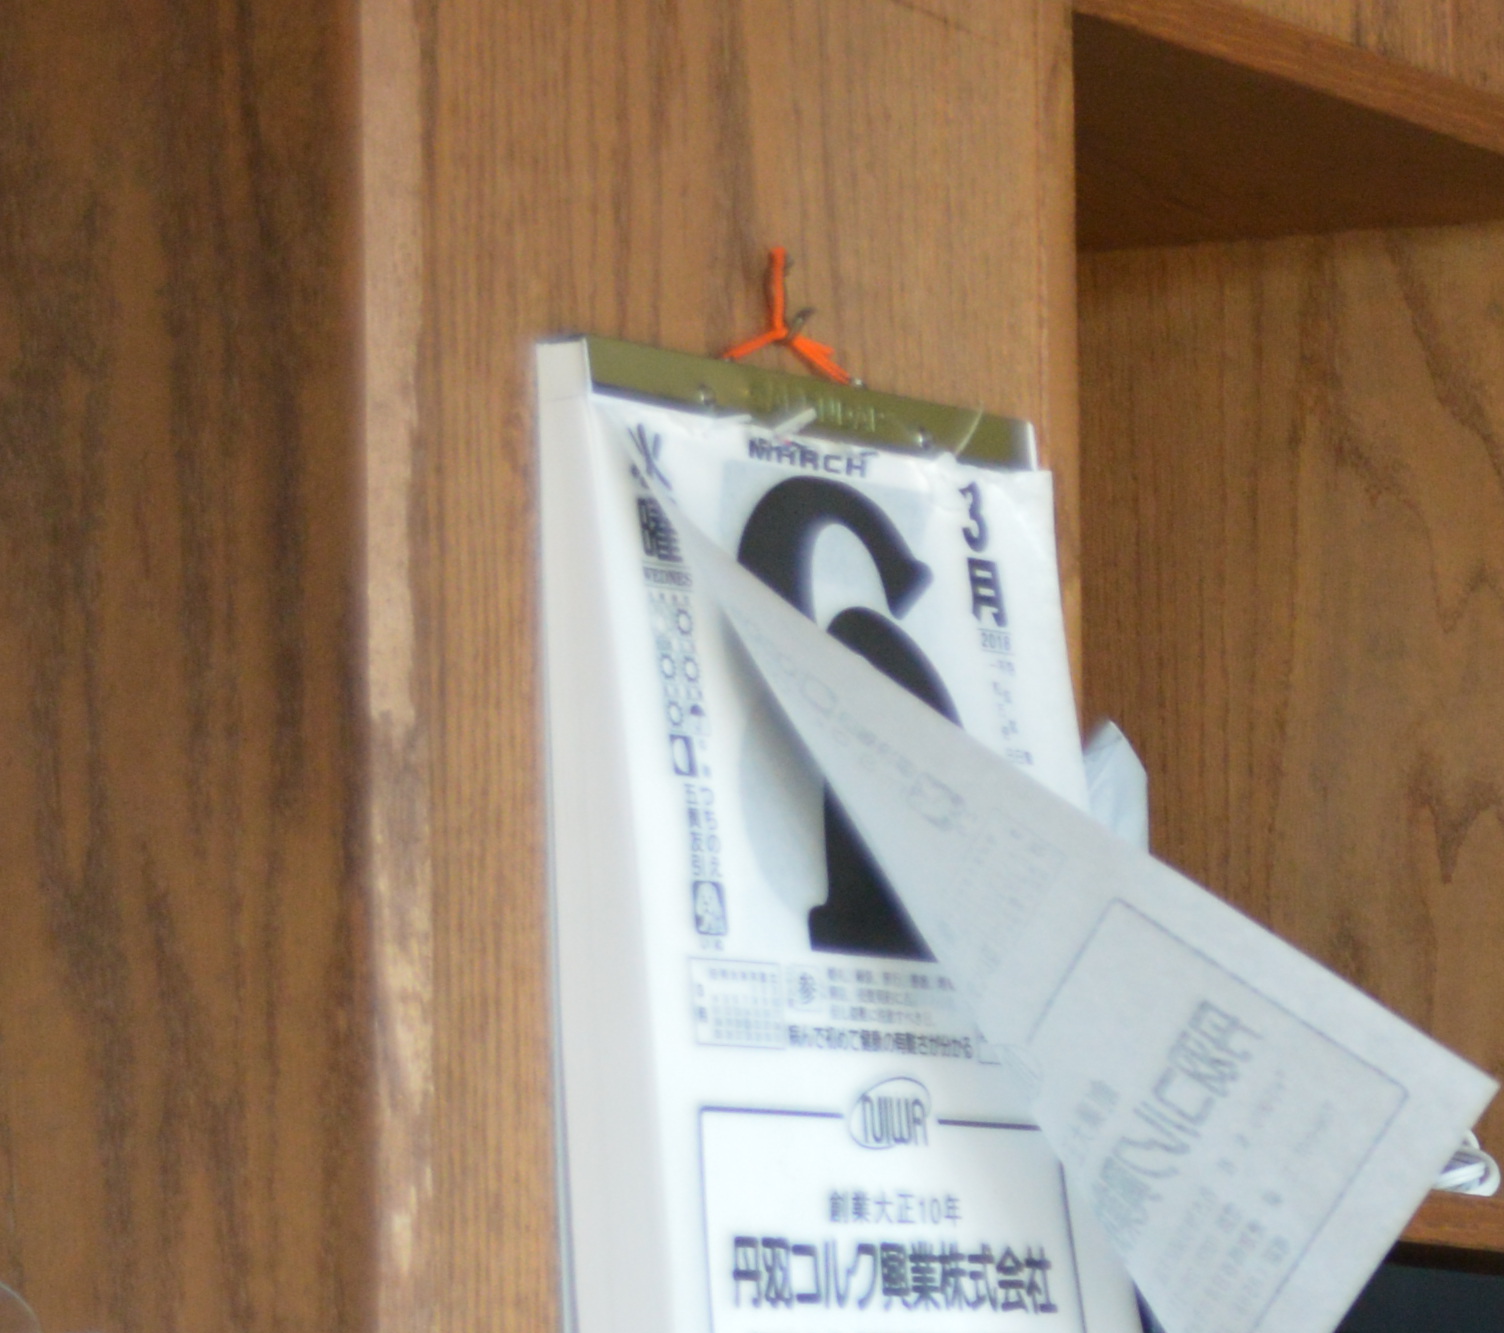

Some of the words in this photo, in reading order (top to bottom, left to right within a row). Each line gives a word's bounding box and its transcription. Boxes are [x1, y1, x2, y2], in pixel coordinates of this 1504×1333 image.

[749, 438, 869, 479] MARCH
[959, 481, 1010, 629] 3月
[980, 632, 1011, 651] 2018
